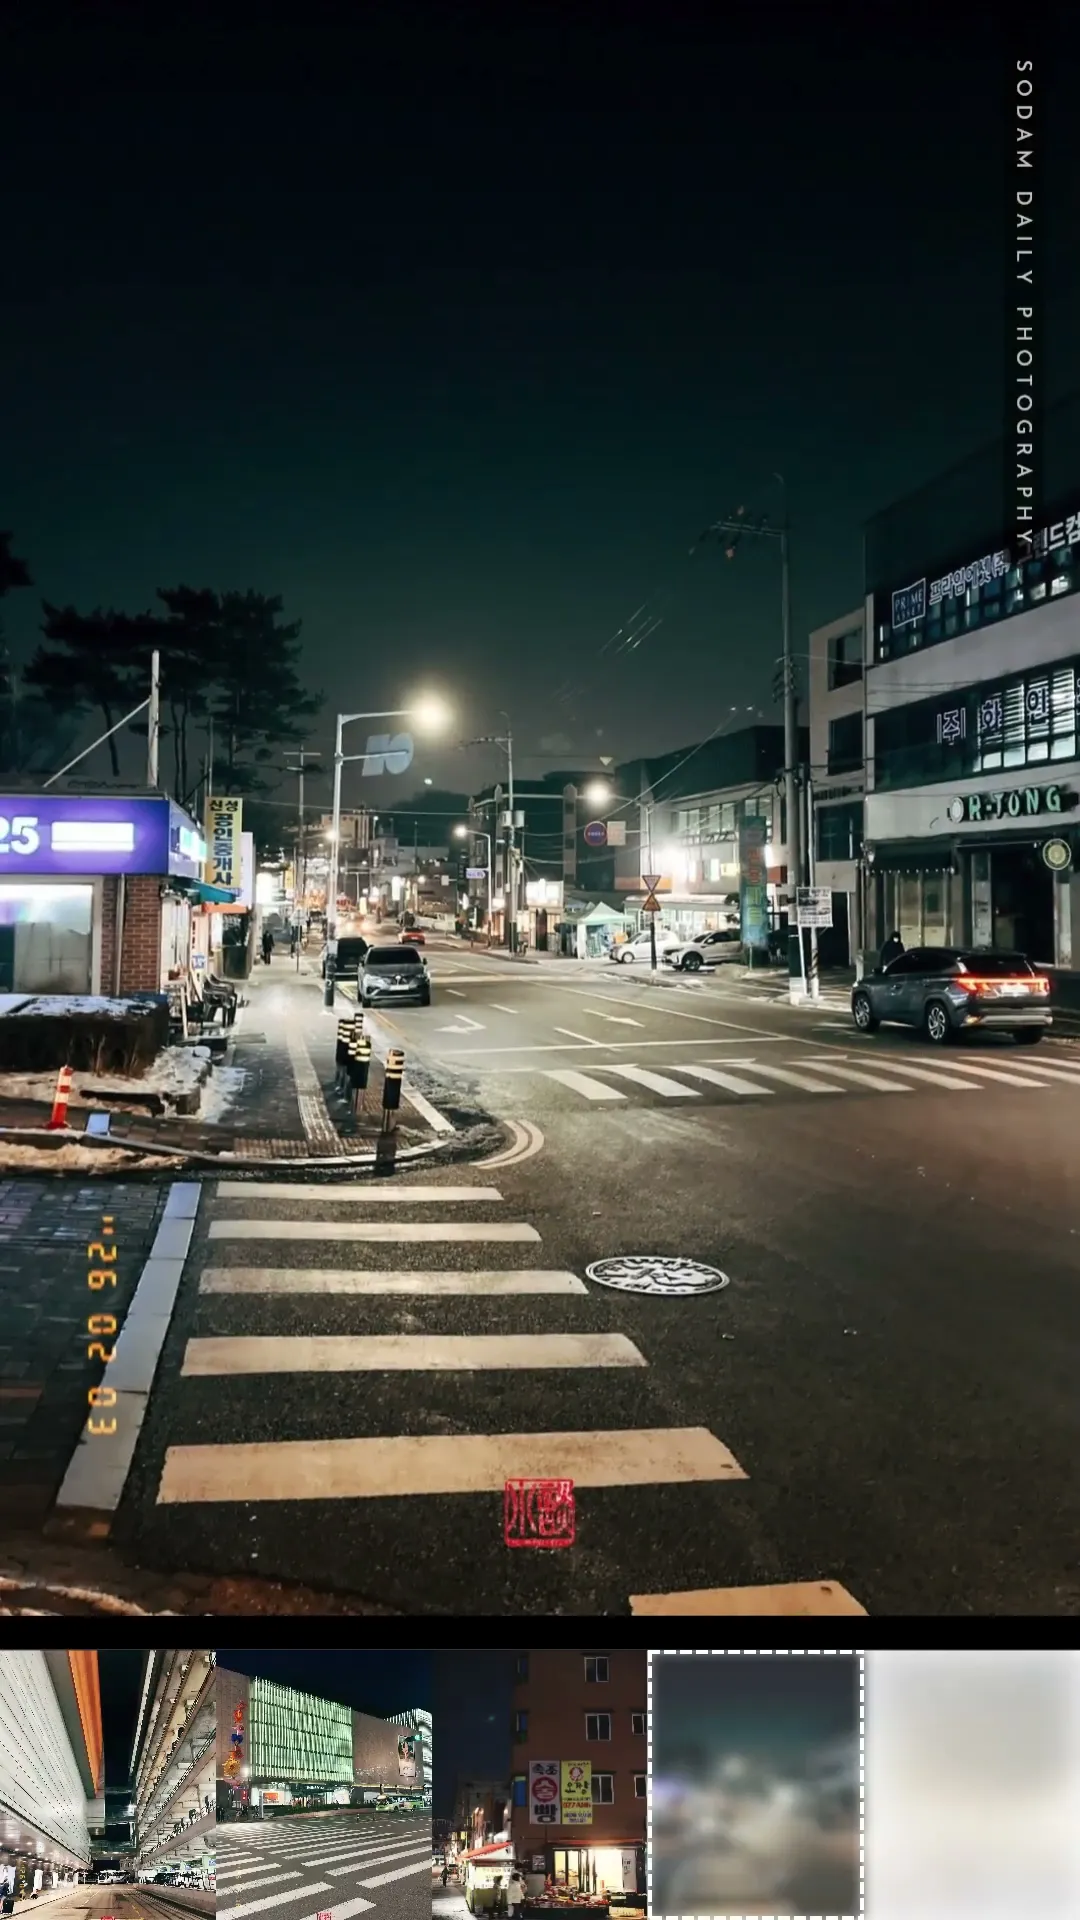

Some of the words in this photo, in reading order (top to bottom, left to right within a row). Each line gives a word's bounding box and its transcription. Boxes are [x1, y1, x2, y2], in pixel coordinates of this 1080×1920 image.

[895, 588, 924, 612] PRIME
[209, 800, 239, 812] 신성
[212, 813, 233, 886] 공인중개사
